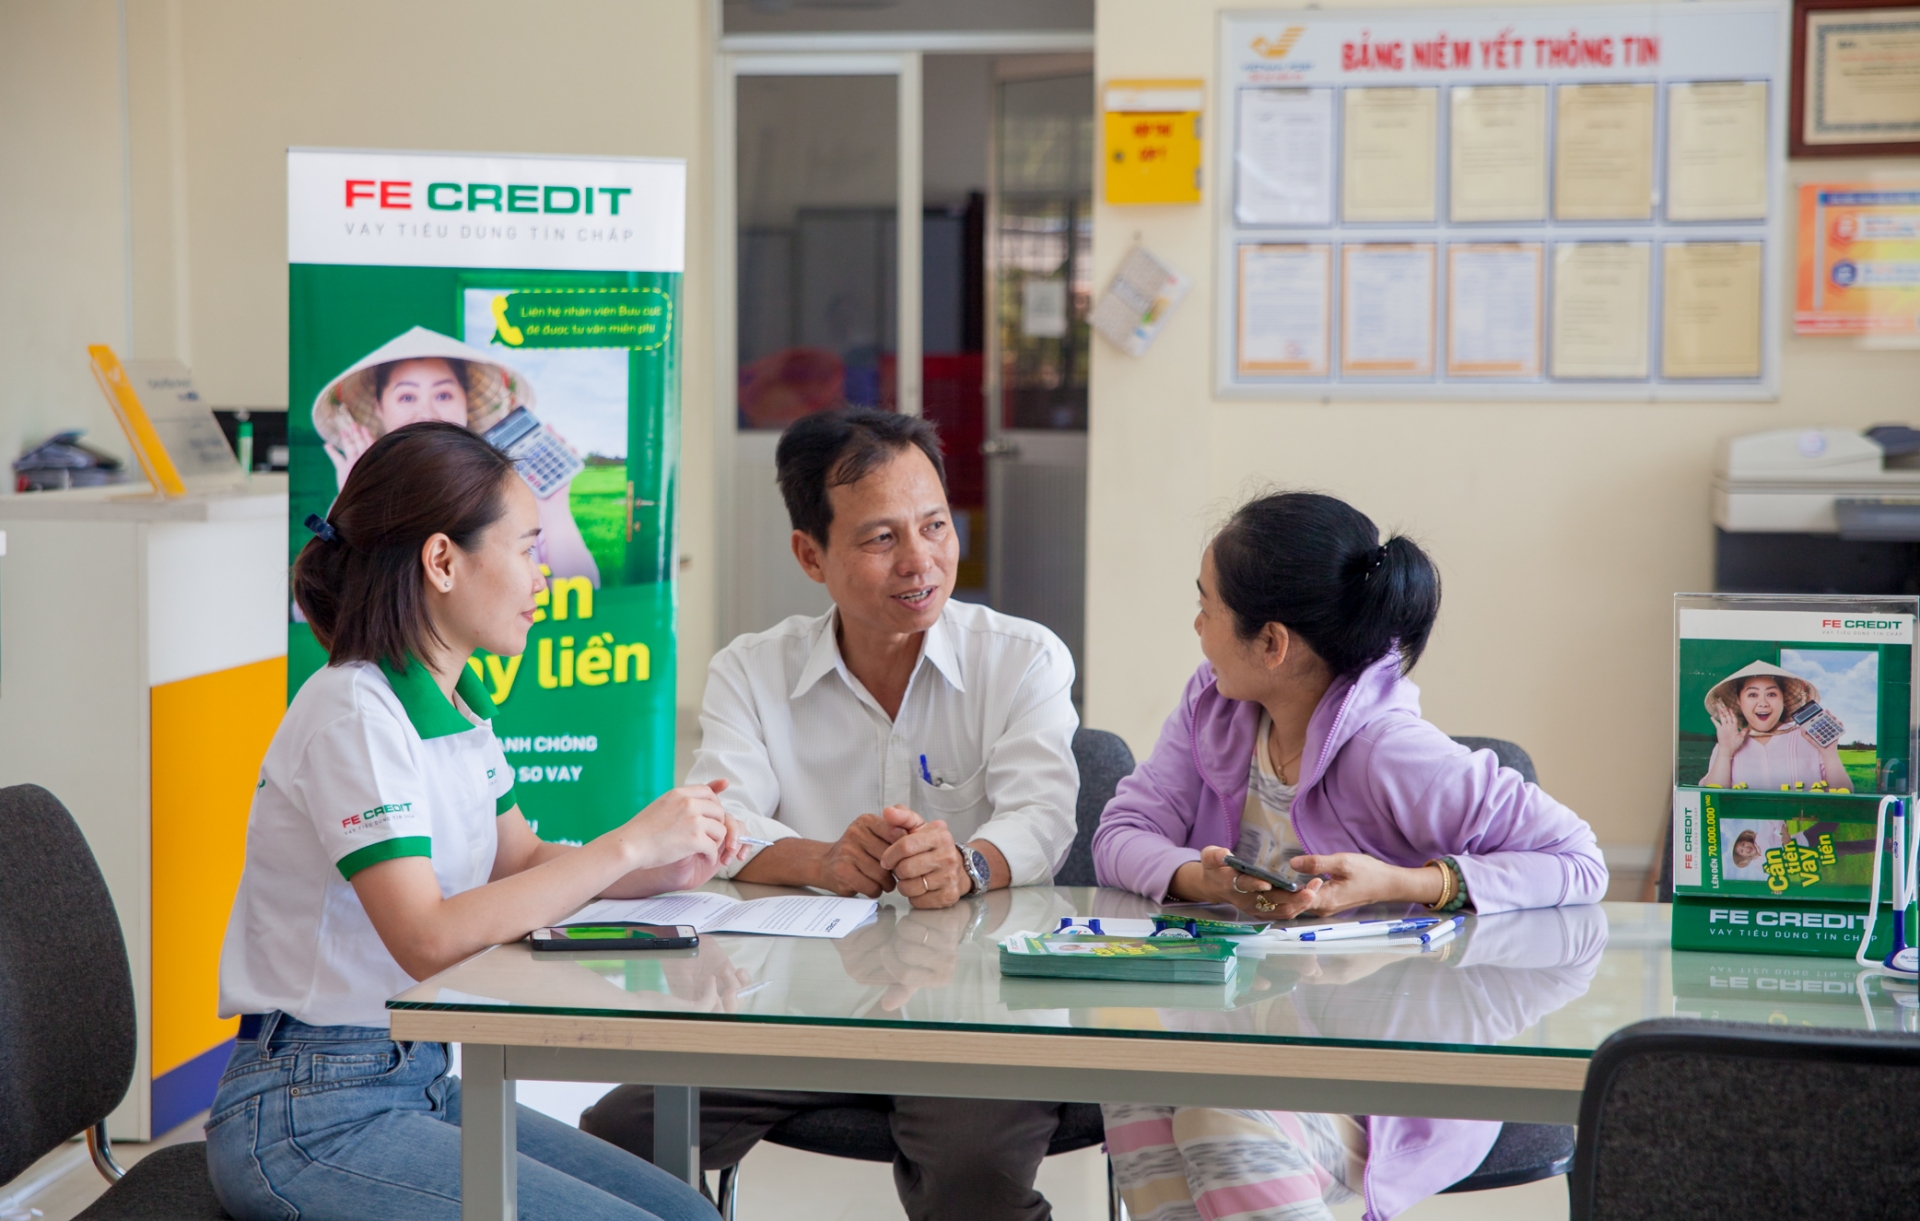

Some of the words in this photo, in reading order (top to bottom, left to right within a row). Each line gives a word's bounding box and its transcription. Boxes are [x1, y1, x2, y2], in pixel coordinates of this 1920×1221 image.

[1621, 37, 1661, 68] TIN
[345, 179, 412, 209] FE
[427, 182, 632, 216] CREDIT
[345, 222, 385, 237] VAY
[1822, 619, 1841, 628] FE
[1844, 620, 1902, 630] CREDIT
[537, 631, 650, 690] liền
[533, 731, 598, 752] CHÓNG
[545, 765, 583, 782] VAY
[341, 814, 361, 829] FE
[363, 802, 412, 820] CREDIT
[1684, 807, 1693, 852] CREDIT
[1705, 807, 1718, 857] 70.000.000
[1684, 854, 1693, 869] FE
[1782, 840, 1801, 875] tiền
[1818, 834, 1836, 865] liền
[1763, 849, 1789, 892] Cần
[1798, 847, 1820, 888] Vay
[1709, 908, 1749, 925] FE
[1756, 911, 1871, 930] CREDIT
[1709, 928, 1733, 936] VAY
[1740, 928, 1769, 938] TIÊU
[1775, 930, 1809, 940] DÙNG
[1816, 932, 1837, 941] TÍN
[1843, 934, 1878, 943] CHP
